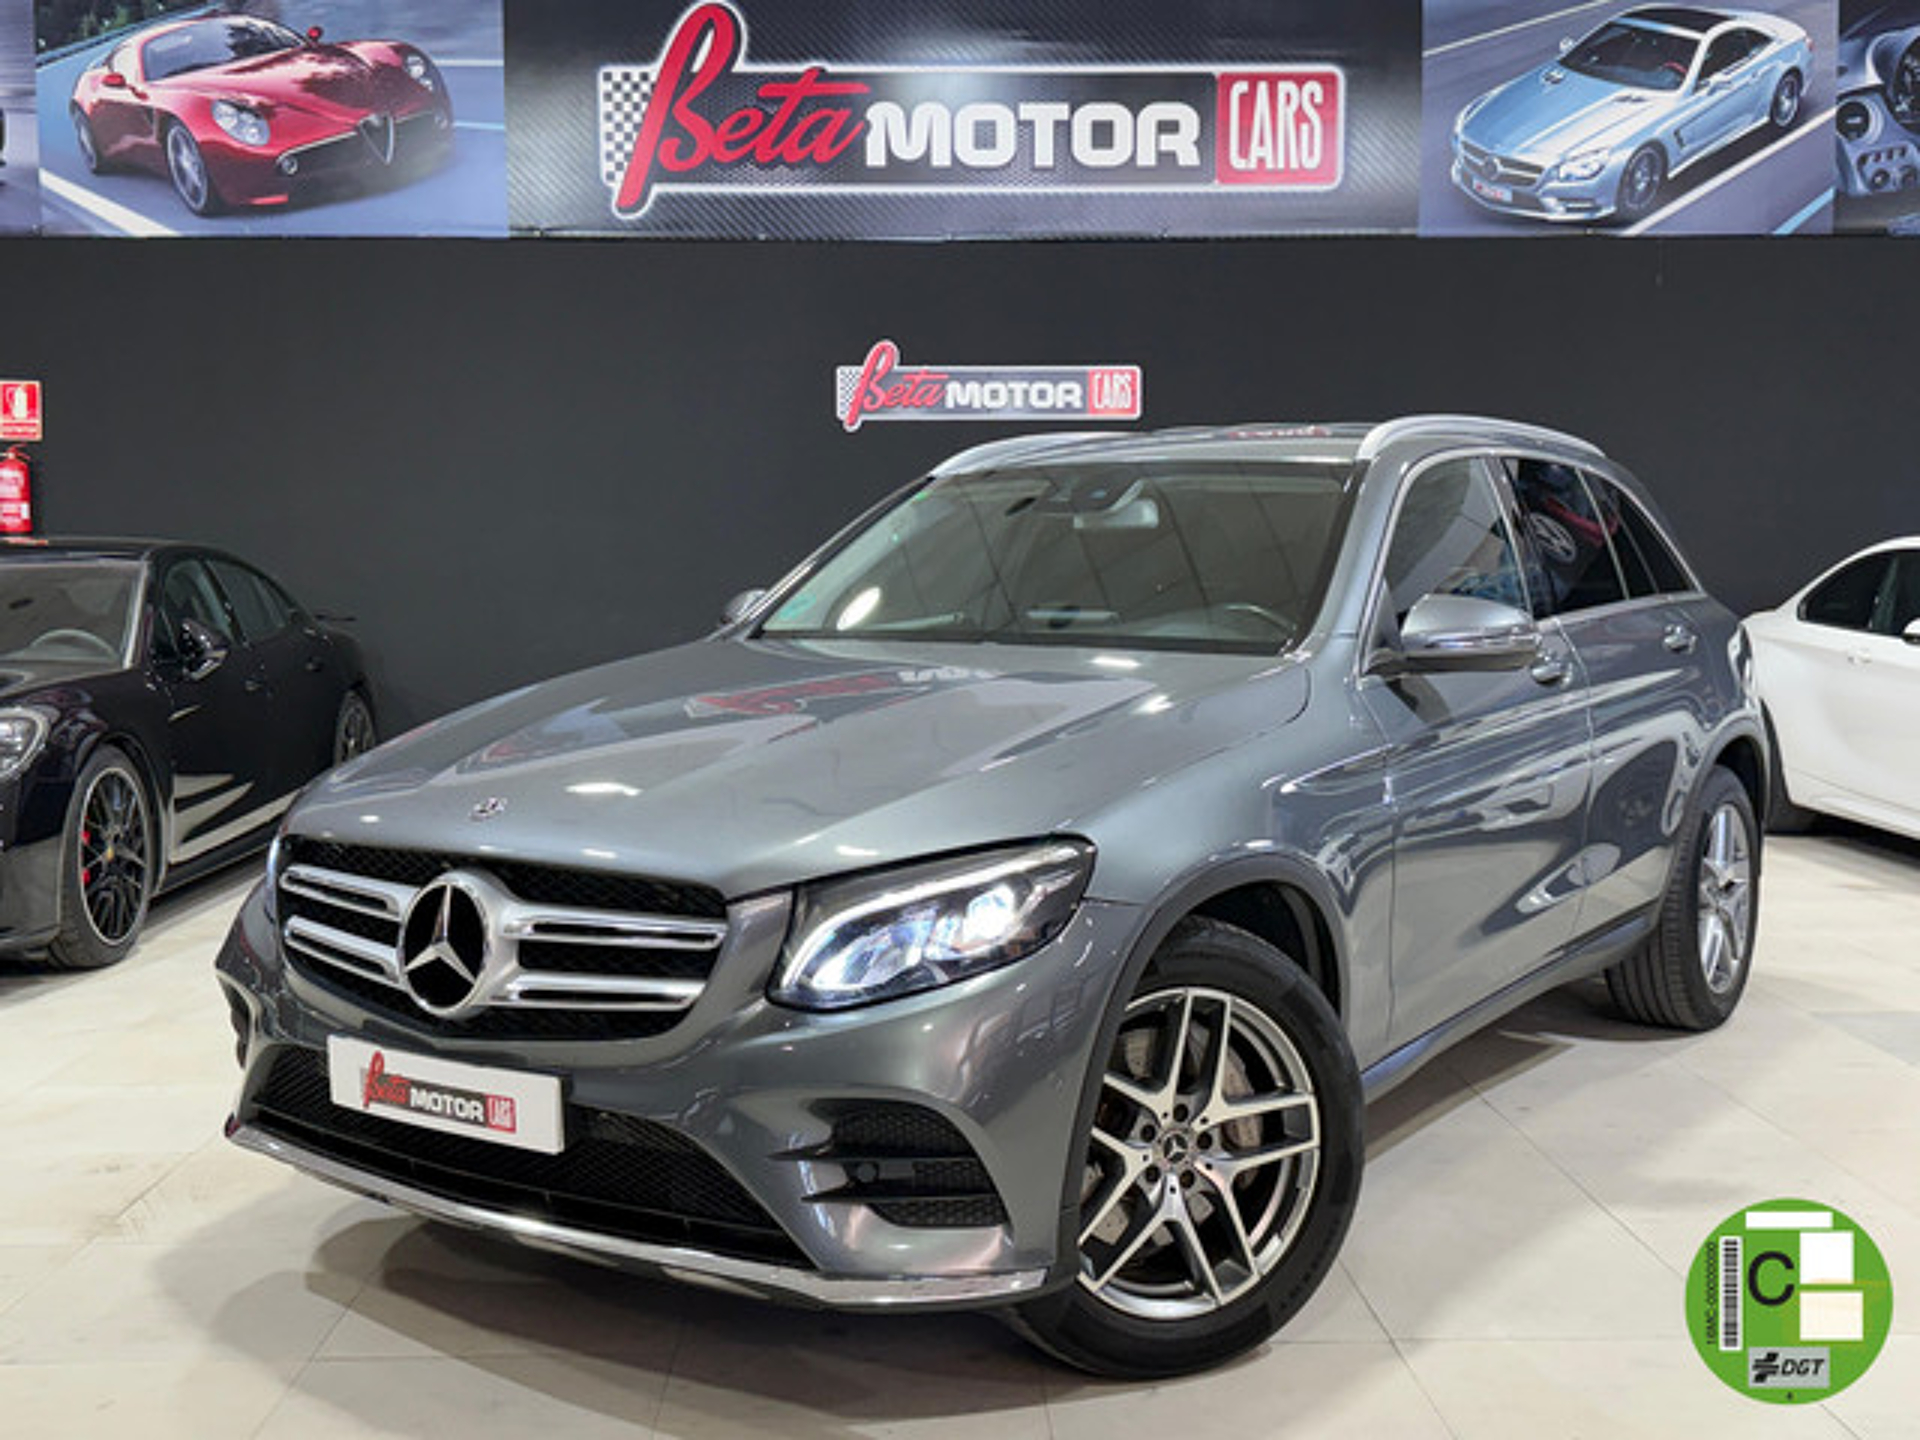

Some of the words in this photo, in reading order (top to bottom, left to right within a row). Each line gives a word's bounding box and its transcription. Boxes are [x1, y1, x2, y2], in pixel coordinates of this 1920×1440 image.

[617, 2, 869, 208] Beta
[864, 101, 1200, 170] MOTOR
[1227, 79, 1324, 173] CARS
[846, 342, 950, 426] Beta
[945, 381, 1083, 409] MOTOR
[1092, 371, 1133, 410] CARS
[410, 1087, 484, 1122] MOTOR
